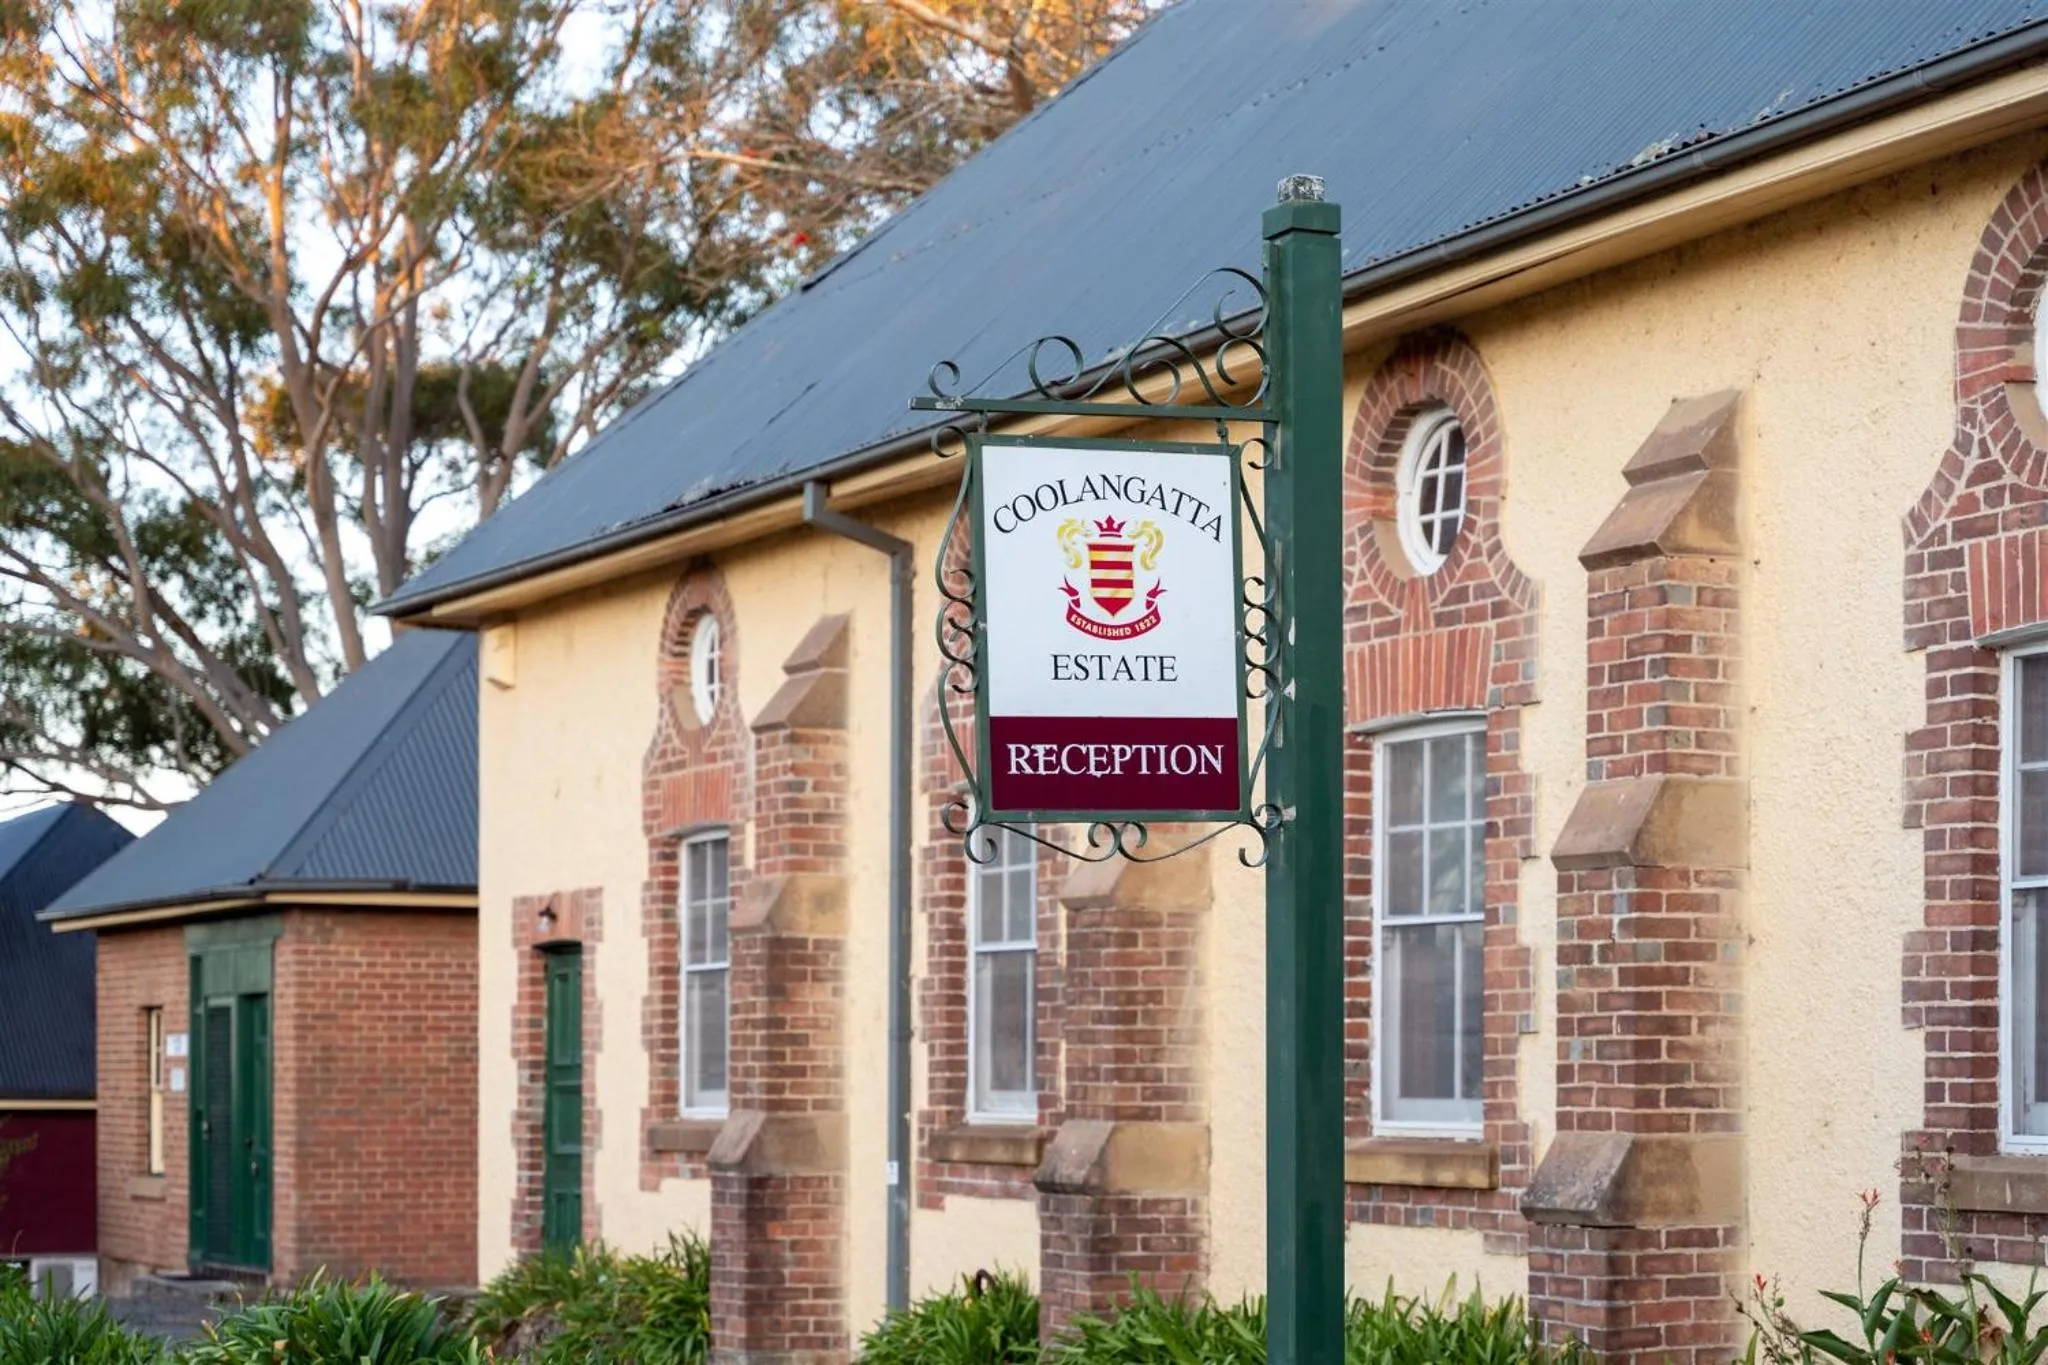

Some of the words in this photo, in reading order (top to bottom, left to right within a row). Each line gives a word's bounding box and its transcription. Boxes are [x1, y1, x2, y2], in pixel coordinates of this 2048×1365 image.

[993, 474, 1224, 543] COOLANGATTA
[1070, 614, 1132, 637] ESTABLISHED
[1135, 615, 1158, 632] 1822
[1051, 654, 1178, 682] ESTATE
[1007, 743, 1224, 778] RECEPTION
